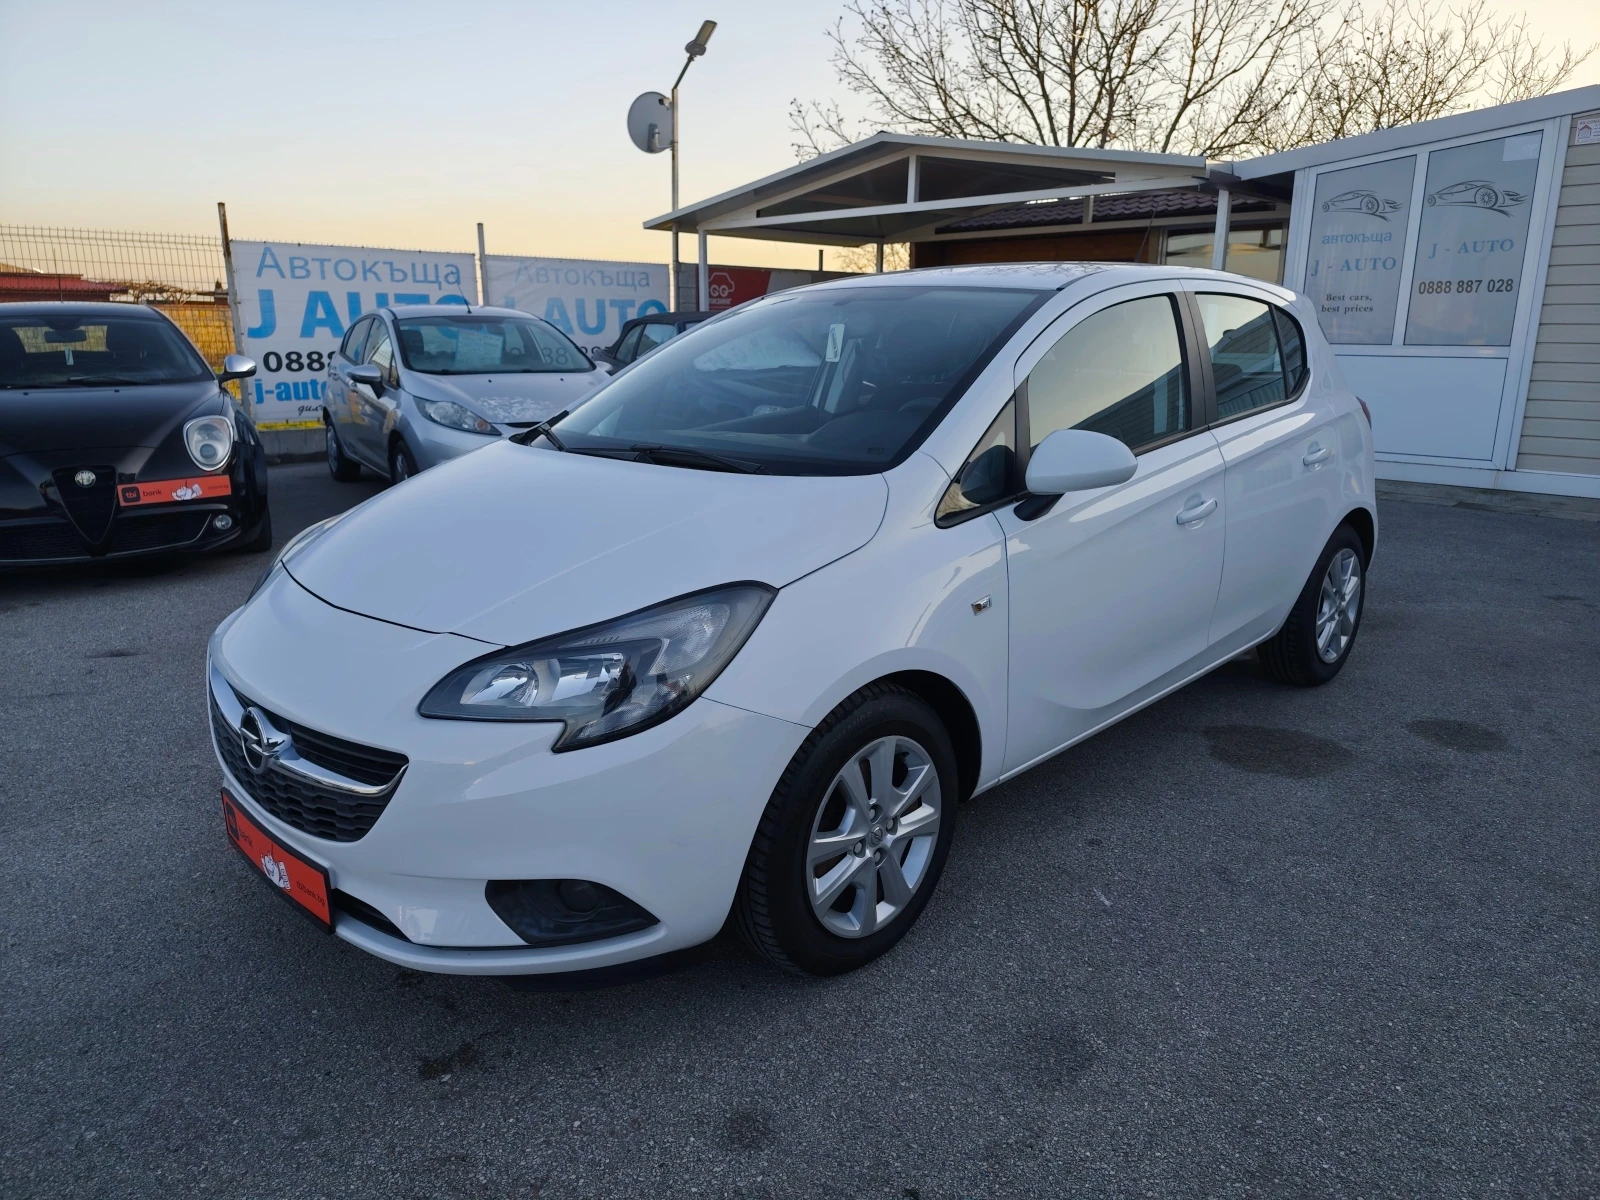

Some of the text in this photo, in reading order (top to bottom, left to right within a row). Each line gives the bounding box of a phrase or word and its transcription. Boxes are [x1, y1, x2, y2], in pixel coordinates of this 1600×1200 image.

[1322, 231, 1392, 245] автокъща
[1428, 243, 1438, 259] J
[1457, 238, 1515, 254] AUTO
[256, 246, 462, 290] Автокъща
[515, 259, 651, 292] Автокъща
[1310, 260, 1320, 277] J
[1340, 256, 1397, 272] AUTO
[1418, 278, 1514, 295] 0888 887 028
[1326, 293, 1373, 302] Best cars,
[247, 289, 277, 339] J
[1321, 304, 1374, 315] best prices
[262, 350, 336, 373] 088
[254, 378, 328, 405] j-aut
[142, 489, 163, 497] bank
